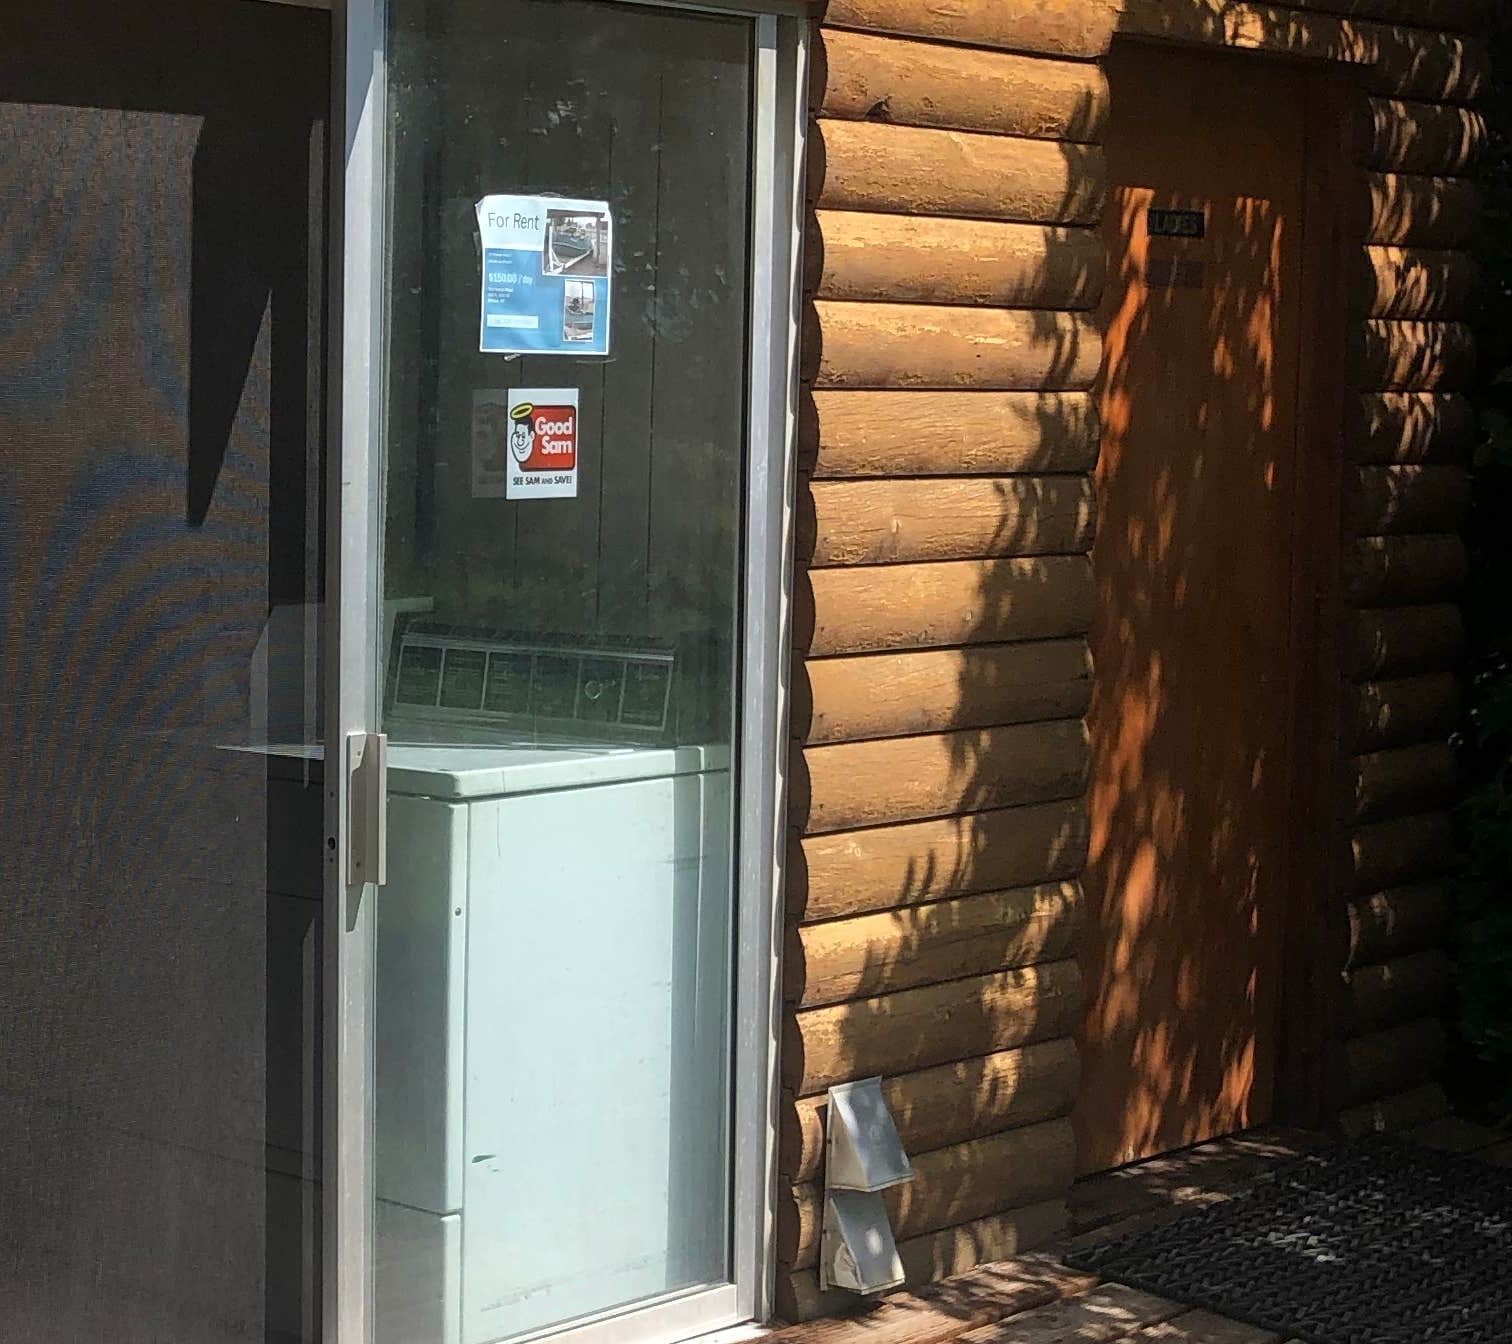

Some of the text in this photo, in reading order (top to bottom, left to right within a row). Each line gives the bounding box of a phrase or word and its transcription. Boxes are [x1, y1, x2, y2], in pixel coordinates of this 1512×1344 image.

[488, 212, 540, 230] For Rent
[535, 416, 573, 435] Good
[541, 436, 573, 454] Sam
[513, 476, 524, 486] SEE
[525, 476, 540, 485] SAM
